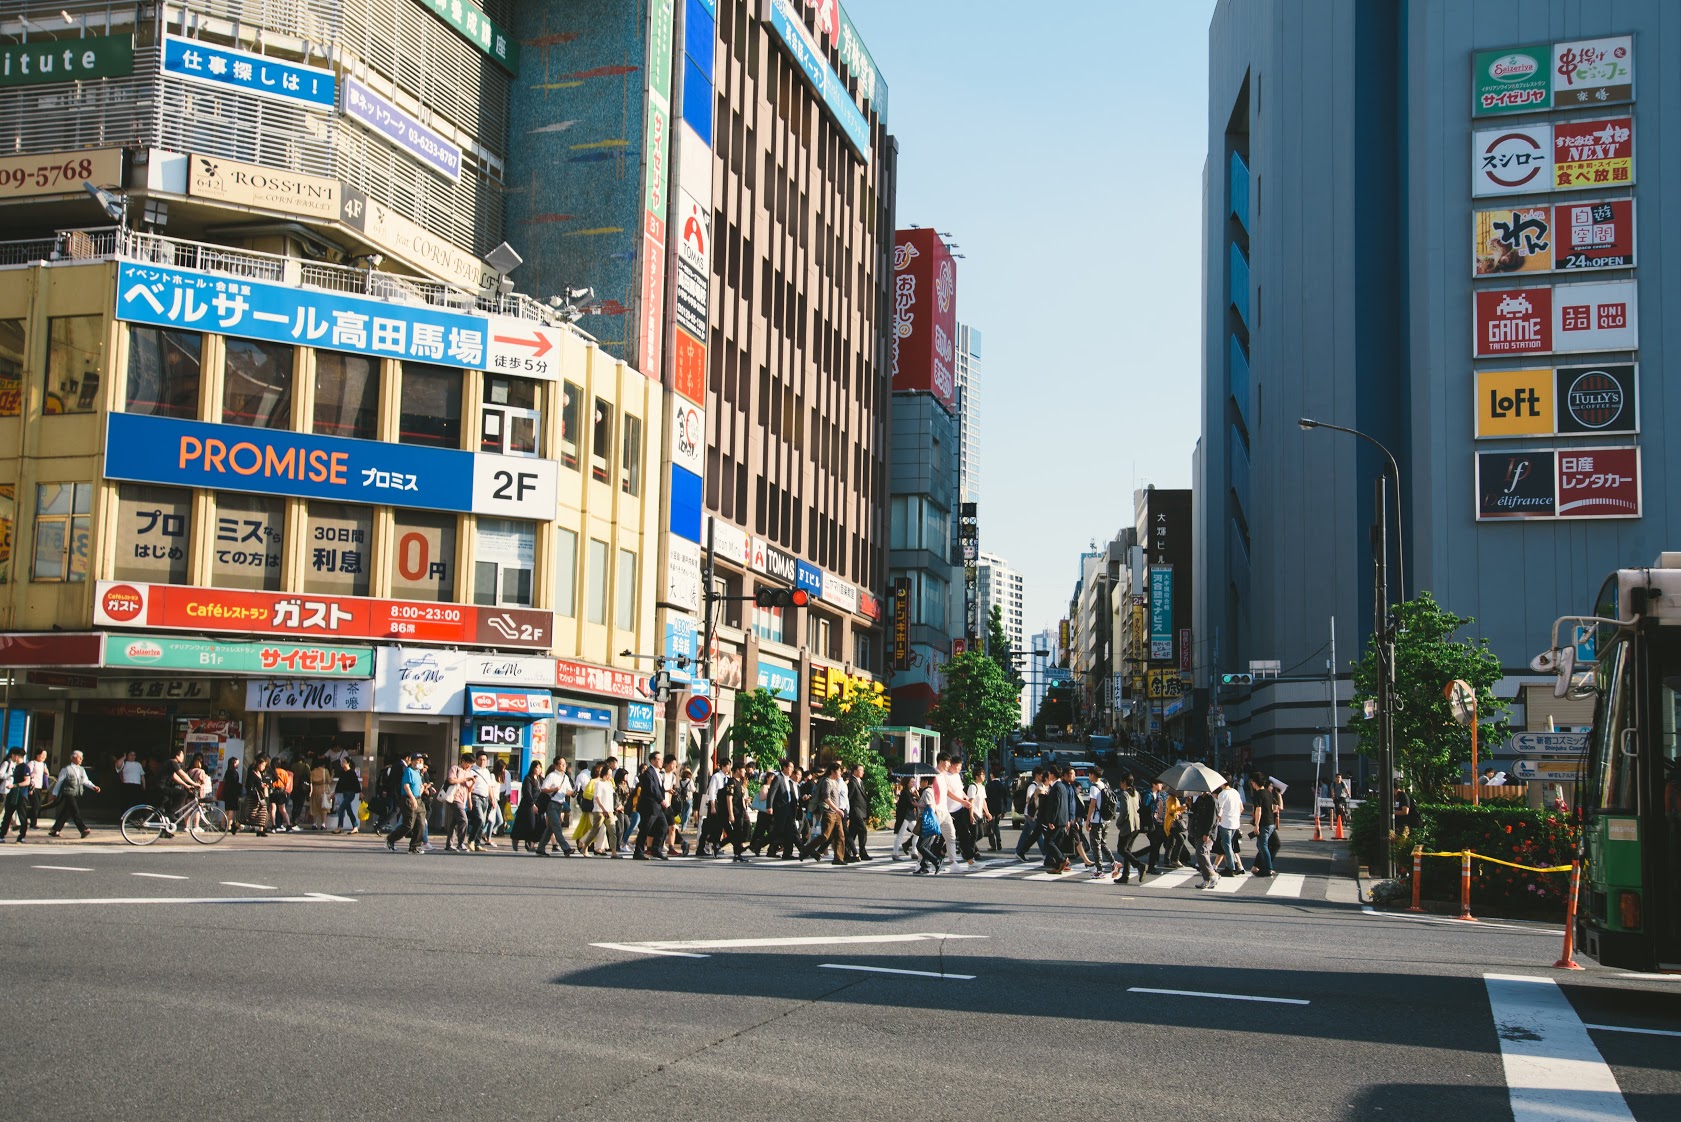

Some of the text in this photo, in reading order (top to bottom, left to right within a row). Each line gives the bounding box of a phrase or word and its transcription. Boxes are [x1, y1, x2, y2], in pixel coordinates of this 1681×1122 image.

[4, 49, 97, 76] itute
[1493, 61, 1534, 79] Saizeriya
[1482, 88, 1545, 108] サイゼリヤ
[1555, 123, 1630, 148] すたみな太郎
[1481, 152, 1546, 170] スシロー
[1567, 143, 1620, 162] NEXT
[231, 171, 332, 201] ROSSINI
[1556, 166, 1629, 186] 食べ放題
[344, 201, 363, 220] 4F
[1492, 211, 1549, 255] わん
[413, 236, 451, 268] CORN
[1592, 256, 1625, 267] OPEN
[1600, 306, 1622, 316] UNI
[124, 283, 484, 366] ベルサール高田馬場
[1488, 318, 1542, 342] GAME
[1600, 316, 1624, 328] QLO
[1489, 340, 1542, 351] TAITO STATION
[494, 354, 548, 374] 徒歩5分
[179, 435, 350, 486] PROMISE
[1562, 456, 1594, 473] 日産
[361, 467, 419, 492] プロミス
[492, 470, 540, 502] 2F
[1562, 473, 1633, 489] レンタカー
[136, 509, 185, 537] プロ
[314, 526, 364, 545] 30日間
[134, 543, 184, 561] はじめ
[216, 550, 280, 568] ての方は
[312, 547, 363, 574] 利息
[768, 549, 795, 587] TOMAS
[108, 599, 140, 612] ガスト
[186, 599, 354, 631] Caféレストラン ガスト
[389, 622, 416, 635] 86席
[520, 624, 544, 641] 2F
[261, 648, 358, 672] サイゼリヤ
